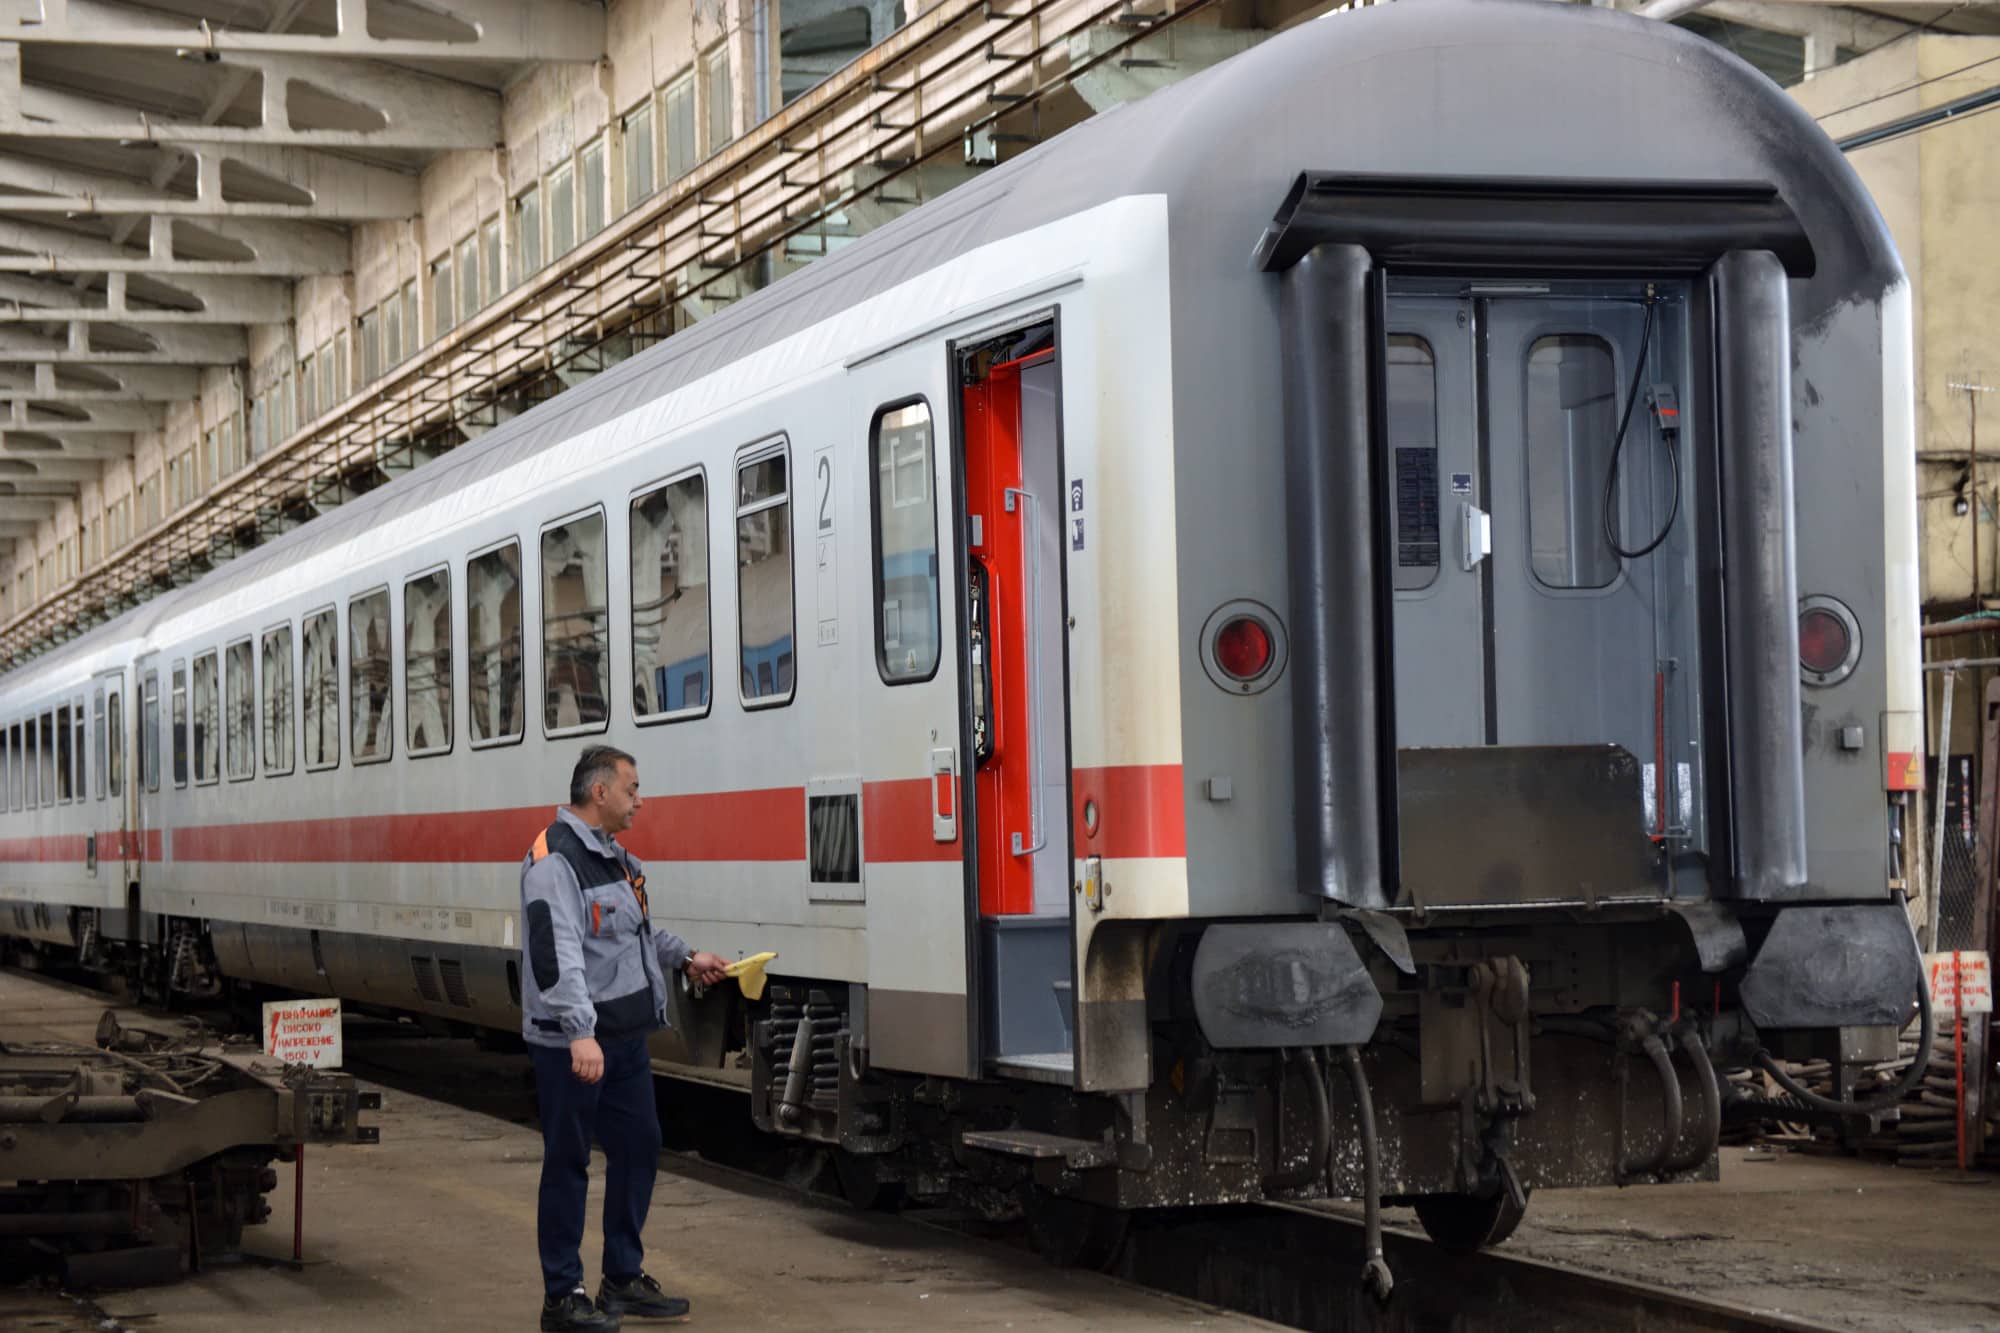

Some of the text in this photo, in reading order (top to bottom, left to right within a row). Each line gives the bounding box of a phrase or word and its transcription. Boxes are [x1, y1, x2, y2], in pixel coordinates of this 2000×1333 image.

[818, 455, 831, 530] 2
[282, 1007, 334, 1020] ВНИМАНИЕ
[282, 1022, 321, 1034] ВИСОКО
[284, 1049, 321, 1061] 1500 V
